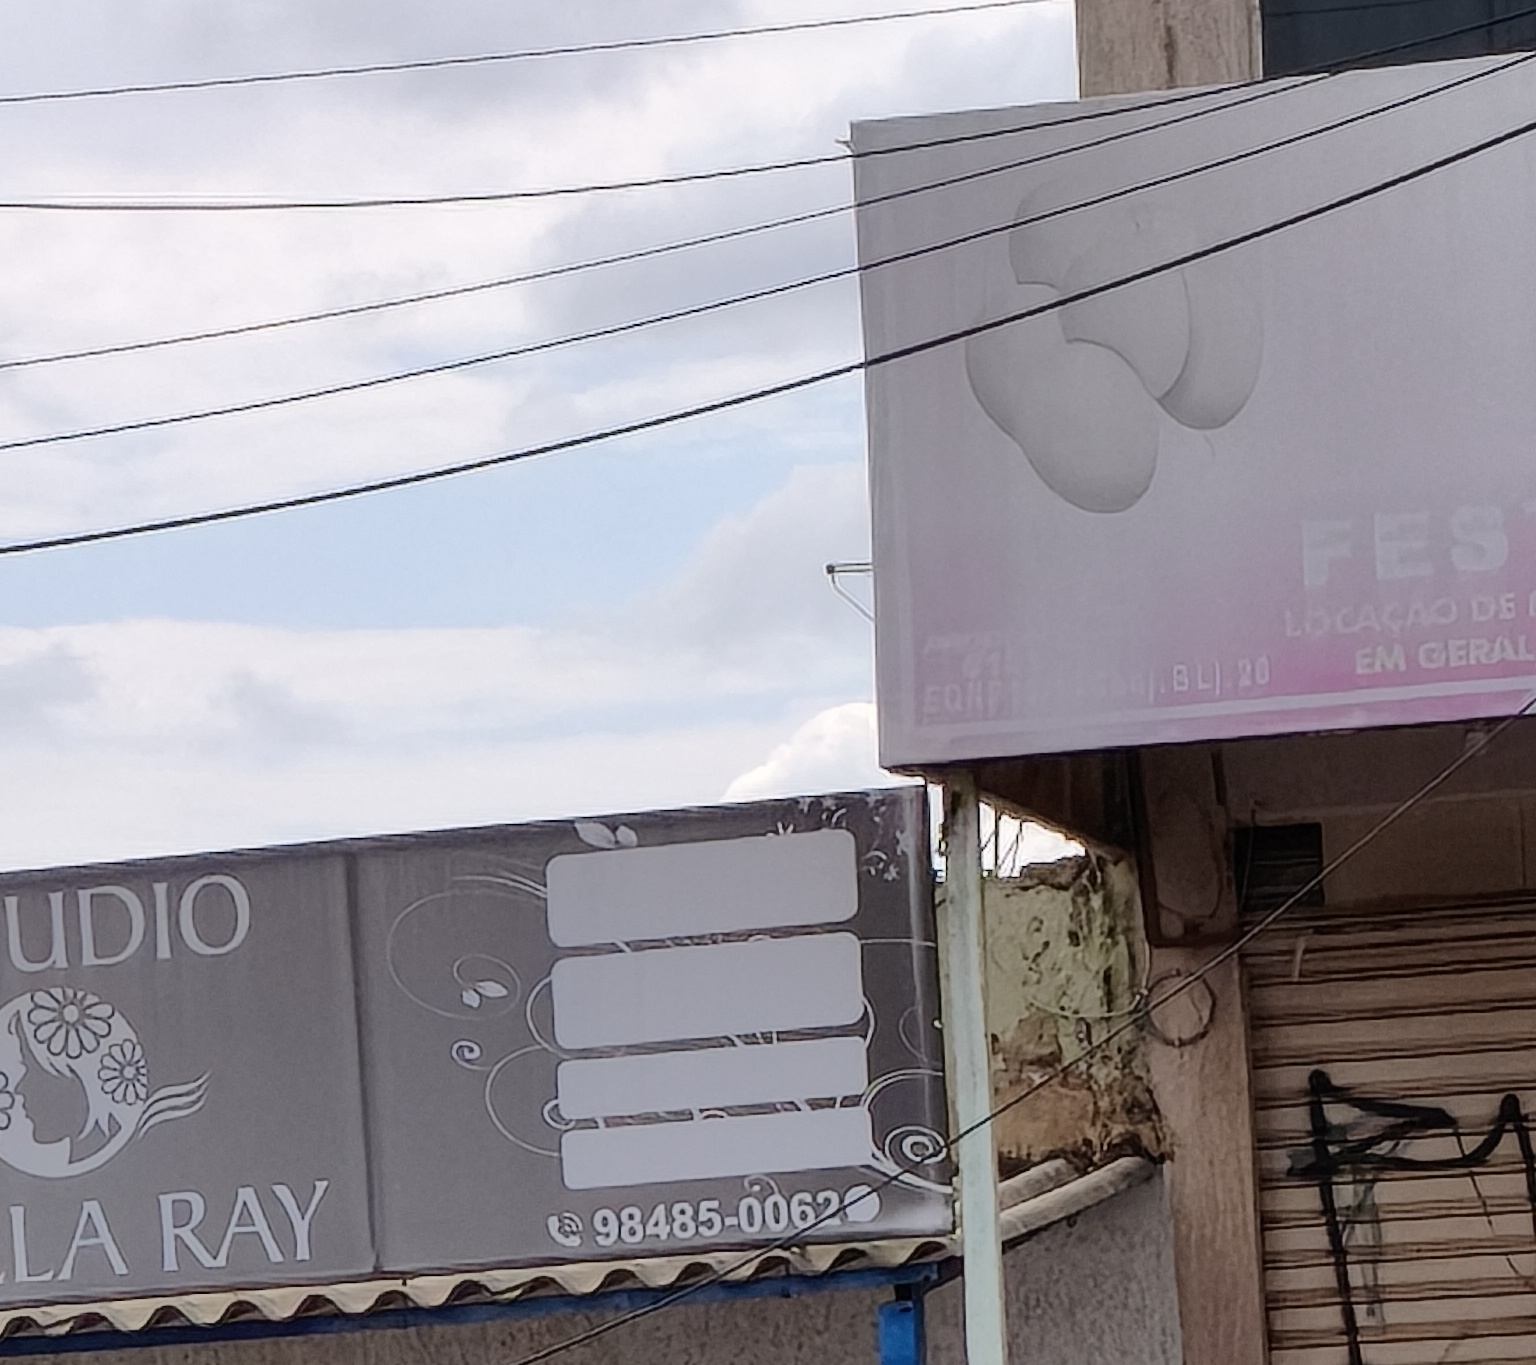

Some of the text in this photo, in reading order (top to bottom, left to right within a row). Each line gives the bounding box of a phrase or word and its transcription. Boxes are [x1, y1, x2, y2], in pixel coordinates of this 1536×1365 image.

[1301, 497, 1536, 587] FES
[1470, 592, 1515, 623] DE
[1355, 633, 1536, 675] EM GERAL
[157, 1179, 330, 1273] RAY
[592, 1188, 843, 1247] 98485-0062
